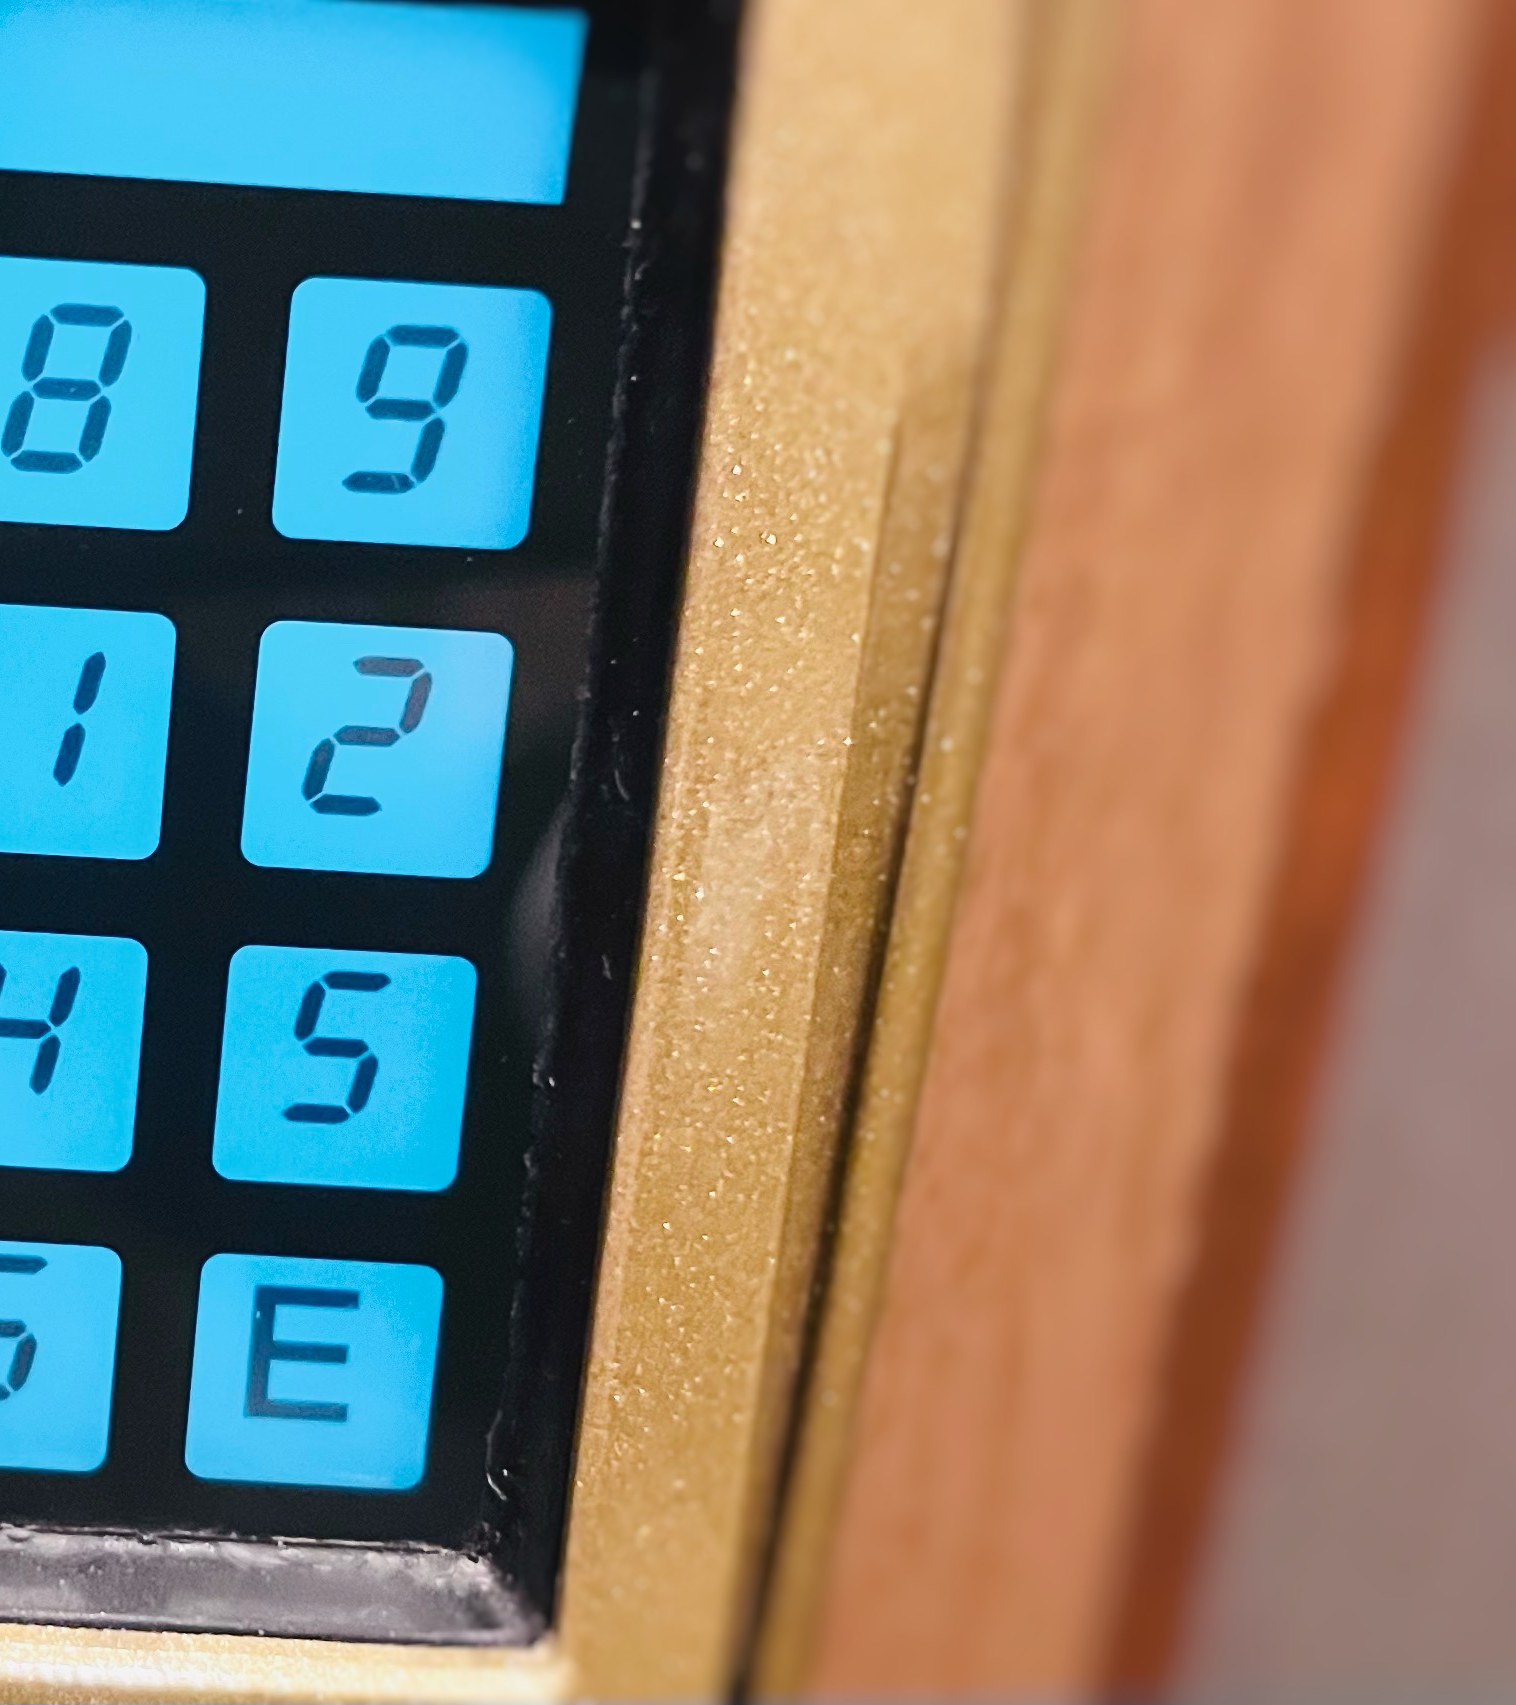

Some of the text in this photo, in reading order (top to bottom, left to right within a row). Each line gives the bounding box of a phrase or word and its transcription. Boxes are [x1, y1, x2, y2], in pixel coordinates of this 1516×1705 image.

[2, 305, 131, 473] 8
[343, 326, 467, 493] 9
[54, 652, 105, 785] 1
[303, 657, 432, 816] 2
[284, 971, 390, 1124] 5
[245, 1285, 360, 1422] E
